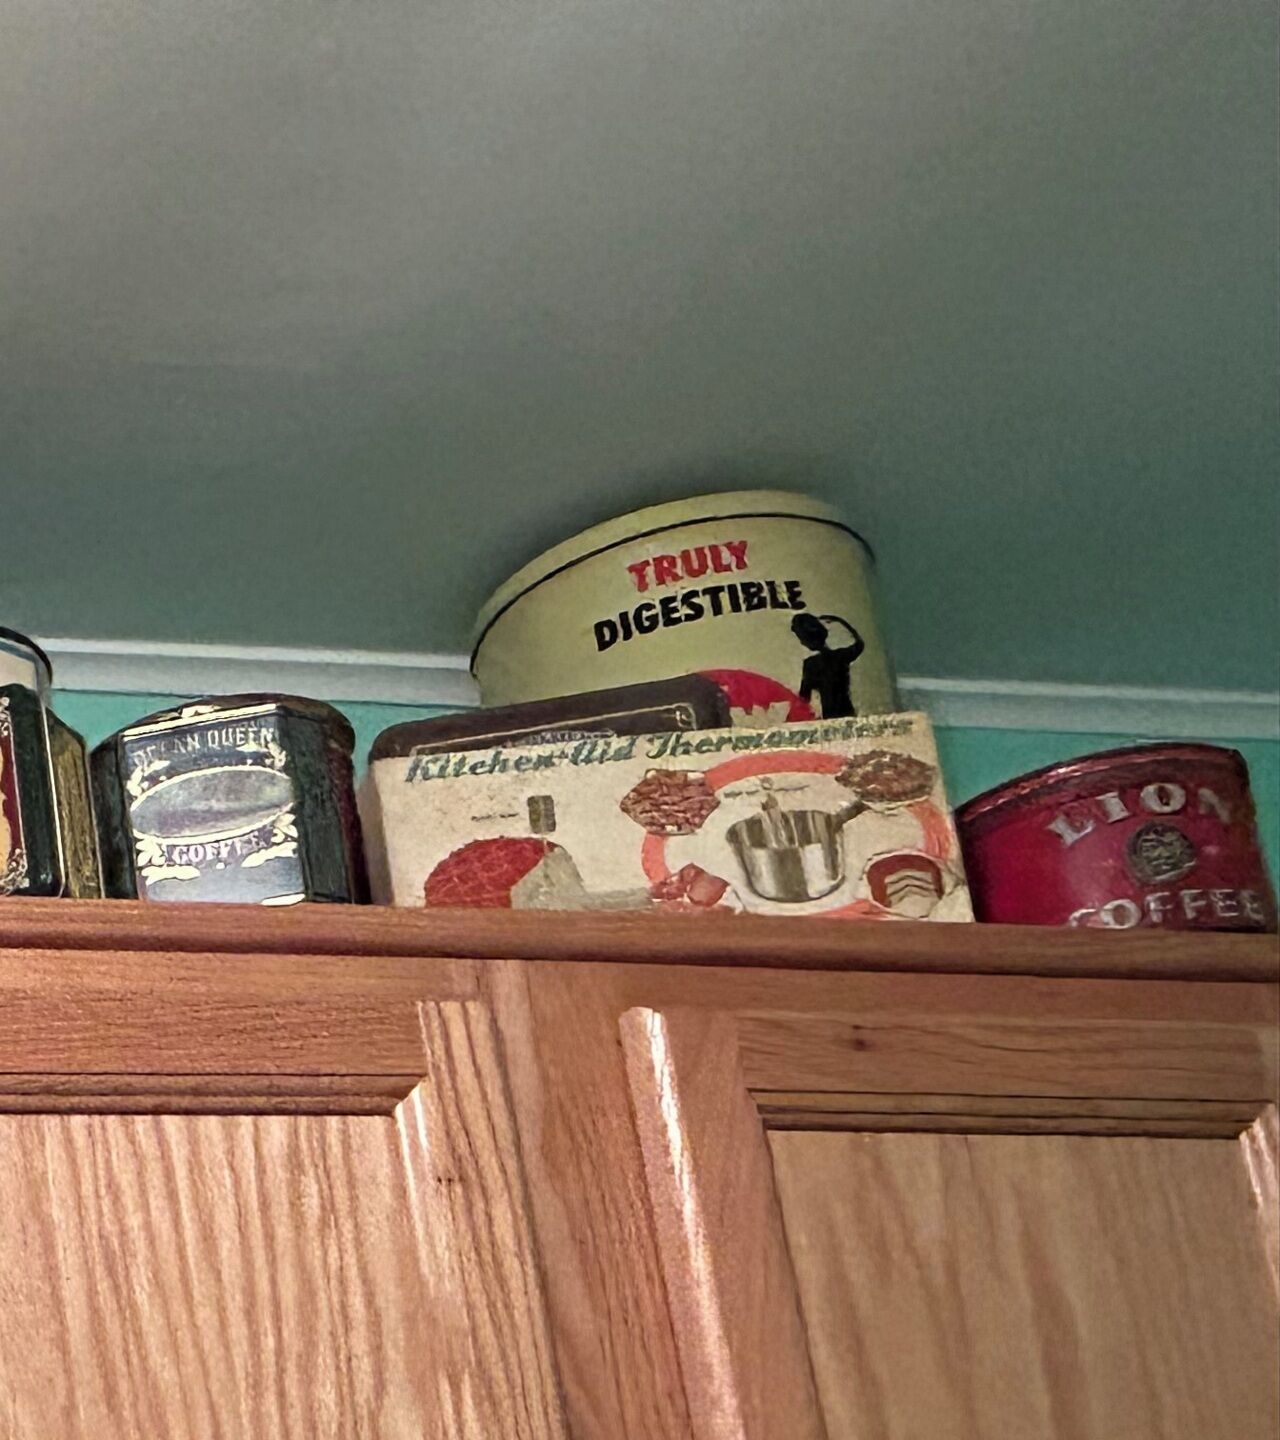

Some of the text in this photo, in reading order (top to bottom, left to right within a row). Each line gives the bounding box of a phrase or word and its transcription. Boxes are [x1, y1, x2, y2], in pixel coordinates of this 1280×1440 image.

[627, 540, 748, 593] TRULY
[593, 580, 807, 652] DIGESTIBLE
[1046, 782, 1233, 847] LION
